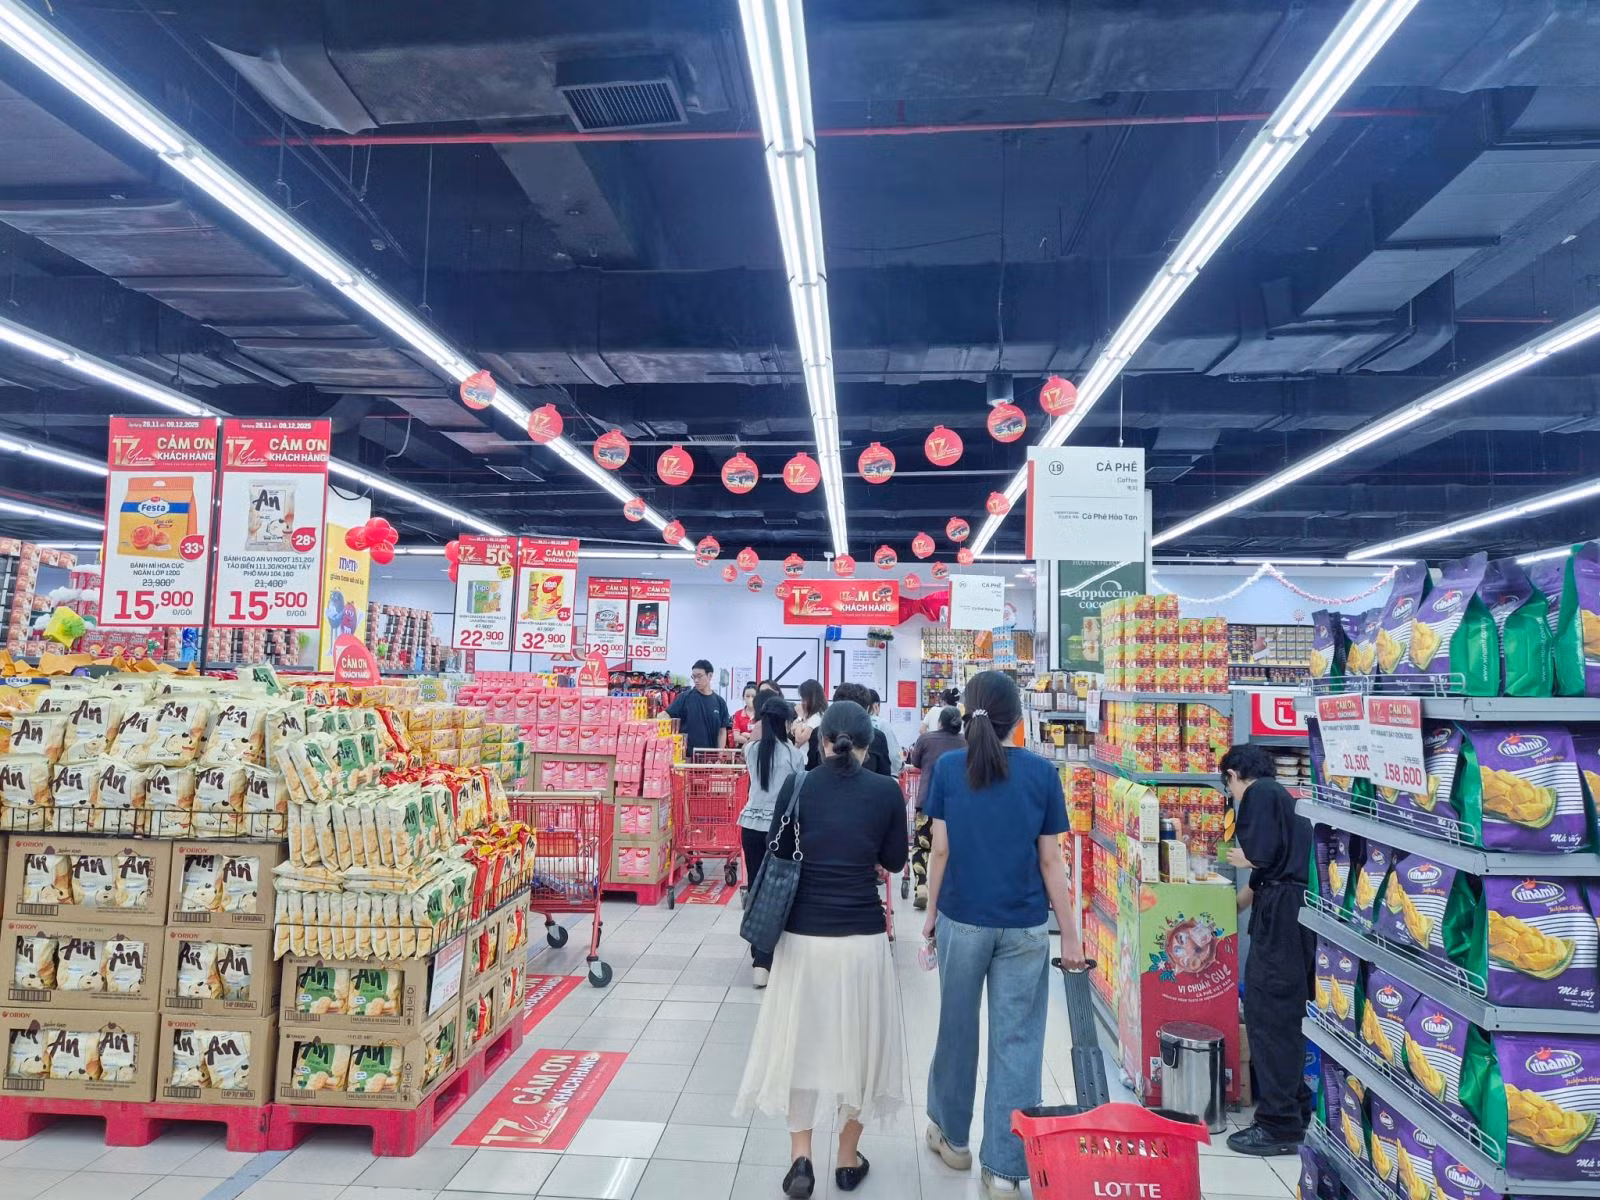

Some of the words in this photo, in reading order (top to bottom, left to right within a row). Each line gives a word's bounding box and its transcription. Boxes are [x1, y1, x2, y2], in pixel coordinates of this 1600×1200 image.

[157, 434, 190, 450] CẢM
[194, 437, 216, 450] ƠN
[269, 434, 303, 451] CẢM
[306, 438, 328, 451] ƠN
[158, 450, 189, 461] KHÁCH
[189, 452, 216, 460] HÀNG
[269, 452, 300, 462] KHÁCH
[1052, 464, 1062, 472] 19
[1115, 461, 1138, 472] PHÊ
[141, 503, 166, 514] Festa
[546, 548, 565, 557] CẢM
[114, 590, 194, 620] 15,900
[228, 590, 308, 621] 15,500
[840, 603, 869, 612] KHÁCH
[869, 603, 892, 612] HÀNG
[460, 630, 504, 647] 22,900
[522, 632, 566, 650] 32,900
[70, 700, 102, 726] An
[12, 719, 44, 746] An
[1503, 737, 1544, 756] vinamit
[50, 767, 84, 793] An
[100, 764, 126, 795] An
[1384, 762, 1422, 786] 158,600
[72, 856, 108, 880] An
[119, 856, 151, 879] An
[223, 859, 253, 884] An
[1517, 886, 1559, 902] vinamit
[17, 936, 34, 964] An
[60, 938, 96, 961] An
[109, 943, 143, 972] An
[218, 948, 250, 976] An
[299, 967, 330, 990] An
[351, 969, 383, 991] An
[48, 1030, 80, 1058] An
[99, 1032, 130, 1057] An
[204, 1036, 242, 1066] An
[300, 1042, 330, 1066] An
[352, 1046, 386, 1066] An
[1530, 1054, 1576, 1073] vinamit
[512, 1074, 561, 1105] CẢM
[539, 1054, 576, 1074] ƠN
[1094, 1181, 1162, 1198] LOTTE
[1449, 1169, 1481, 1188] vinamit
